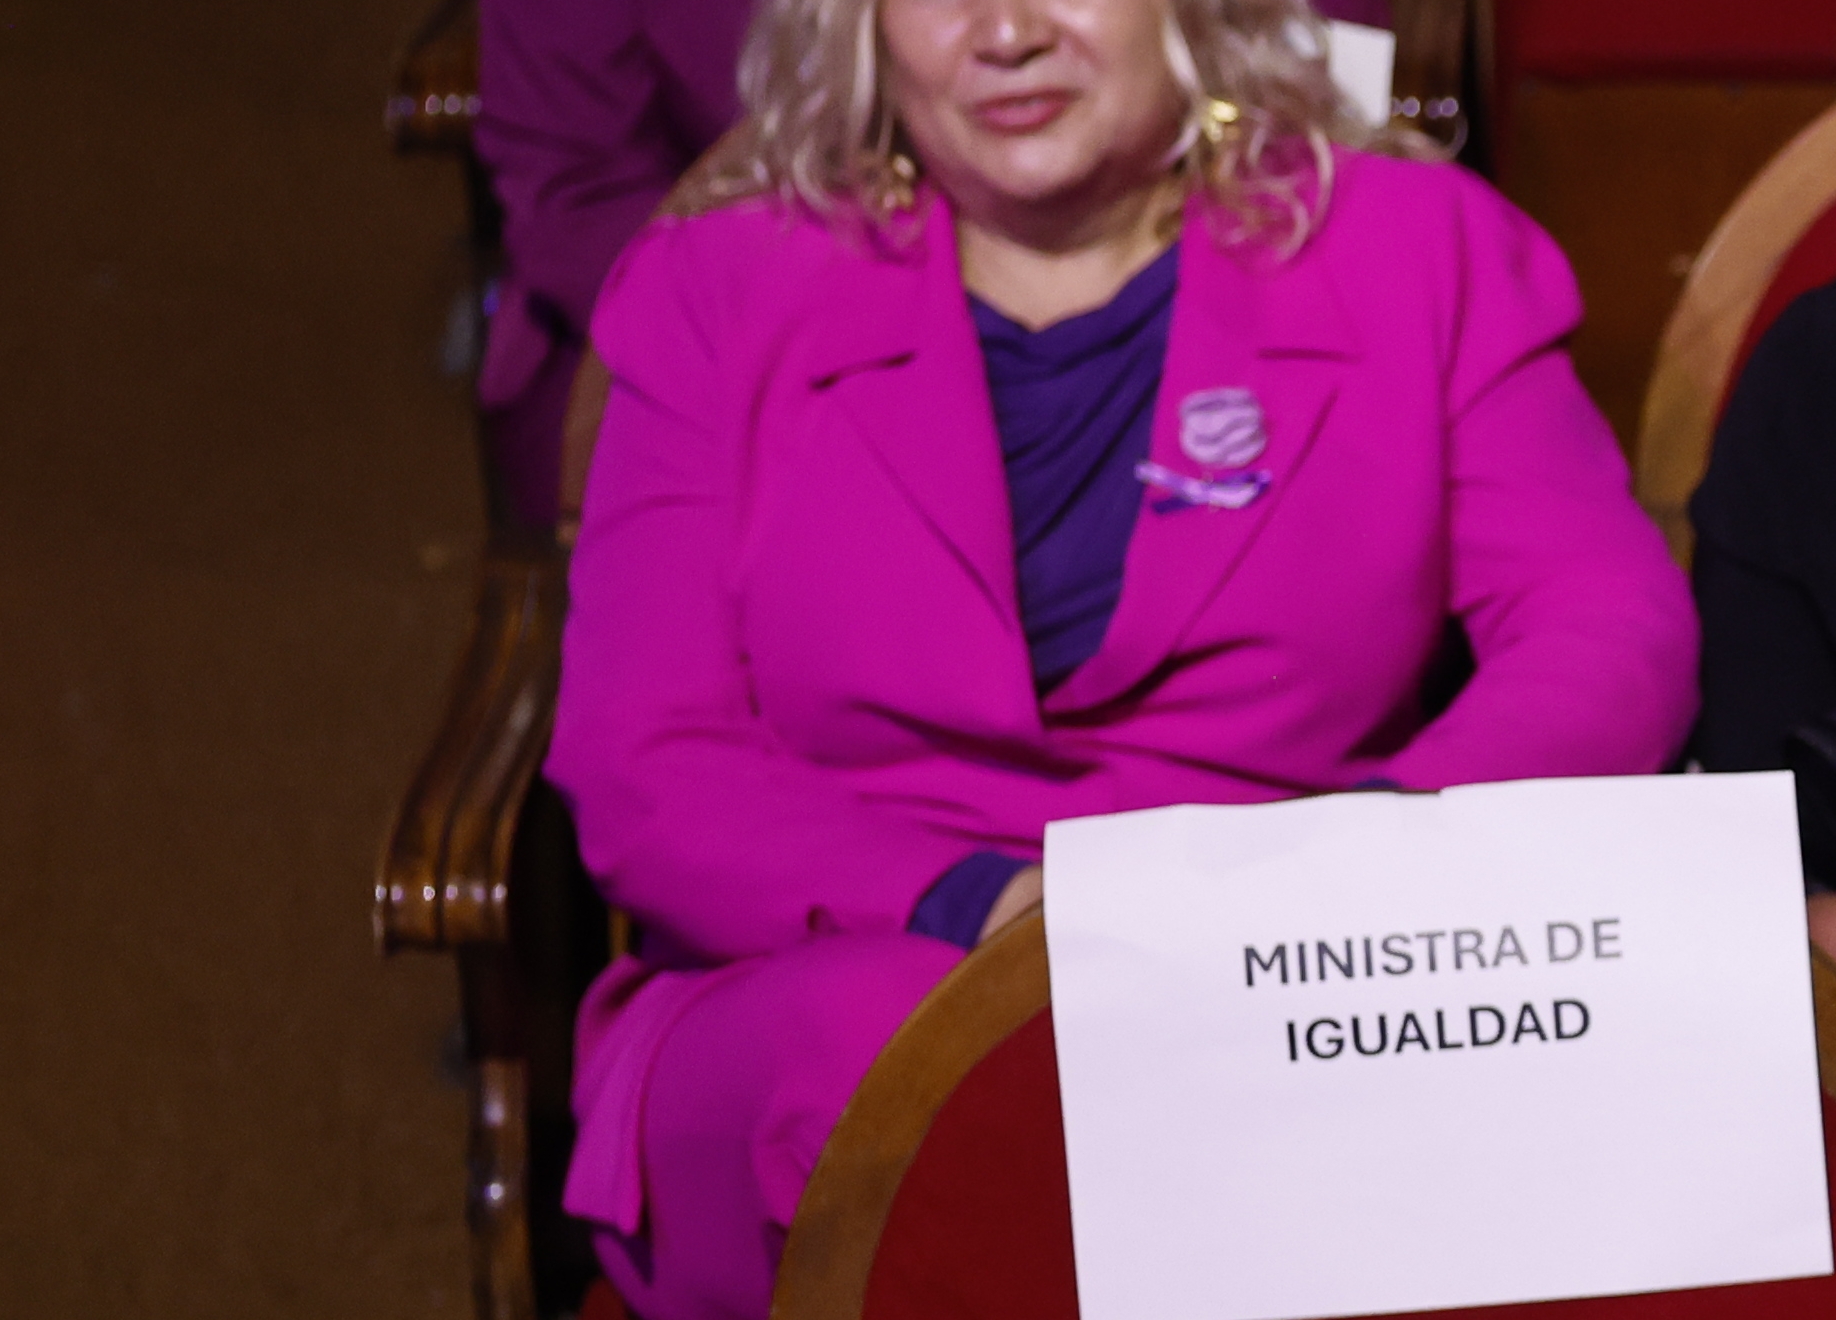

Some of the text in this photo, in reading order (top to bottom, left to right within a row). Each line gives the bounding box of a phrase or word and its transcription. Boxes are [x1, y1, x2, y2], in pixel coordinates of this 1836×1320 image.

[1242, 917, 1622, 989] MINISTRA DE
[1285, 997, 1592, 1063] IGUALDAD
